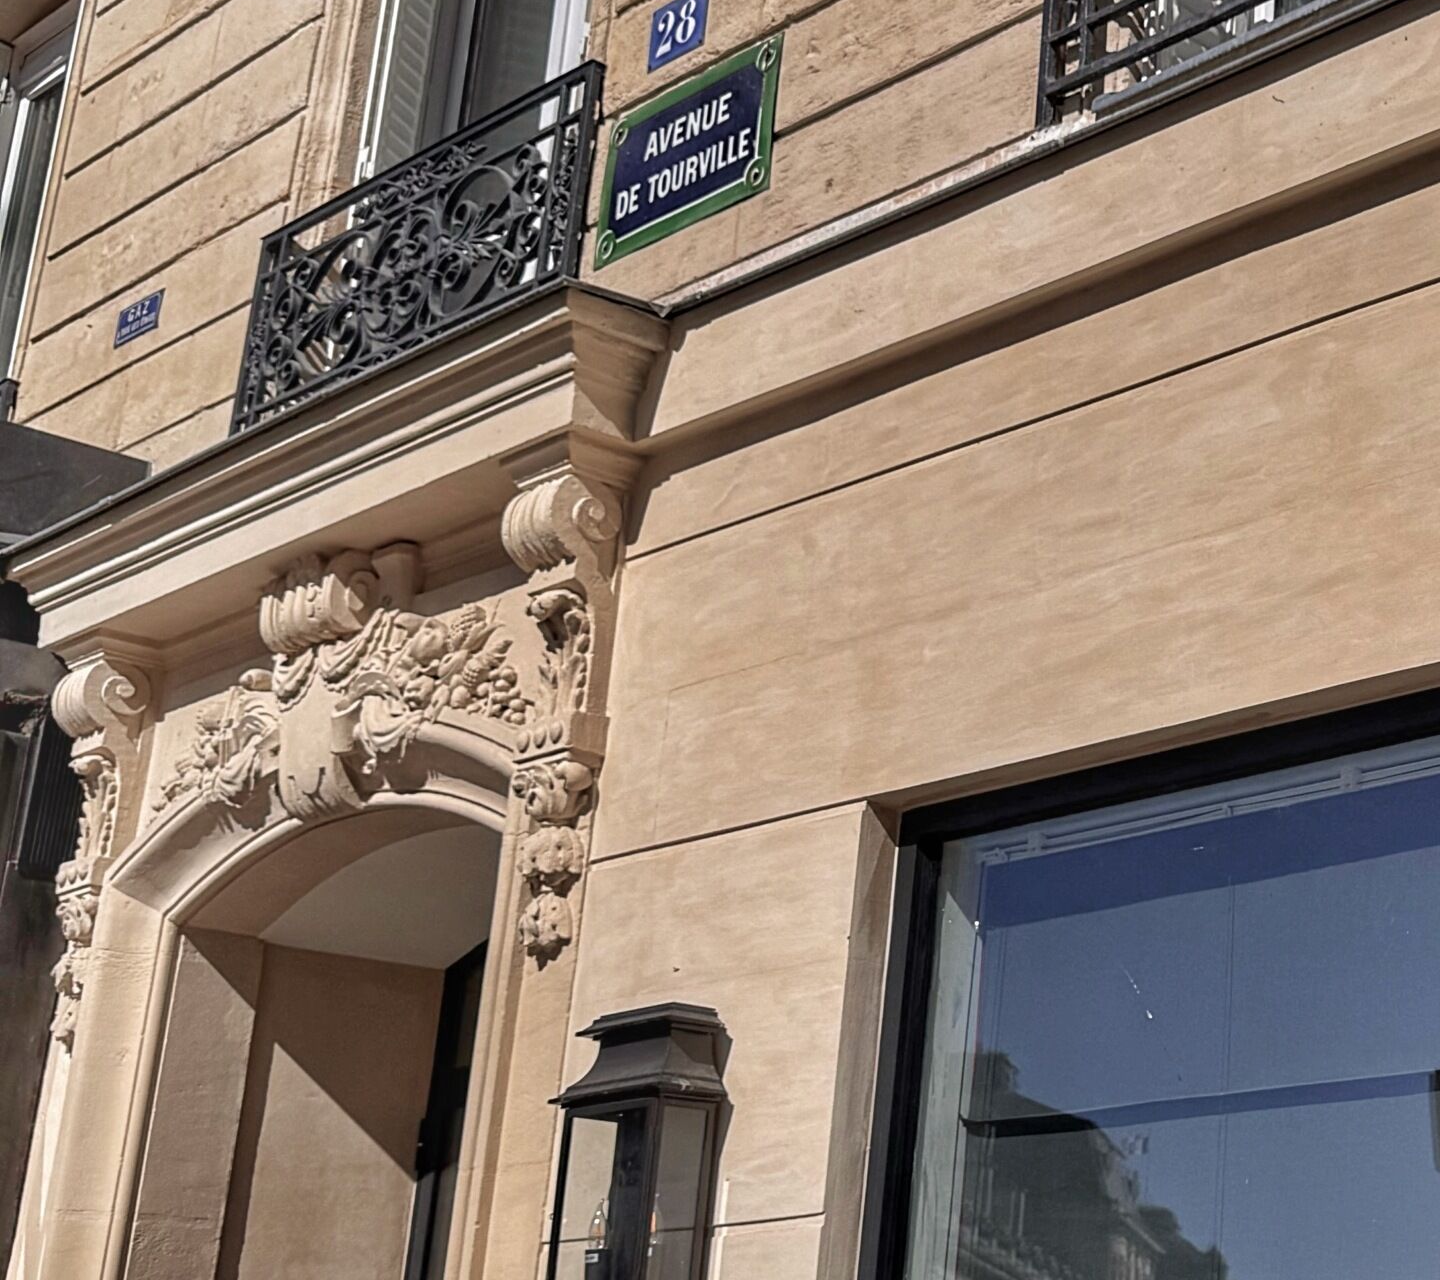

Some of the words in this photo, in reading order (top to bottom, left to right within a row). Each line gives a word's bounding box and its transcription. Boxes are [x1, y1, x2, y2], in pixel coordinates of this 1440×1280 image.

[655, 0, 696, 59] 28
[644, 92, 732, 162] AVENUE
[615, 184, 641, 220] DE
[649, 129, 750, 203] TOURVILLE
